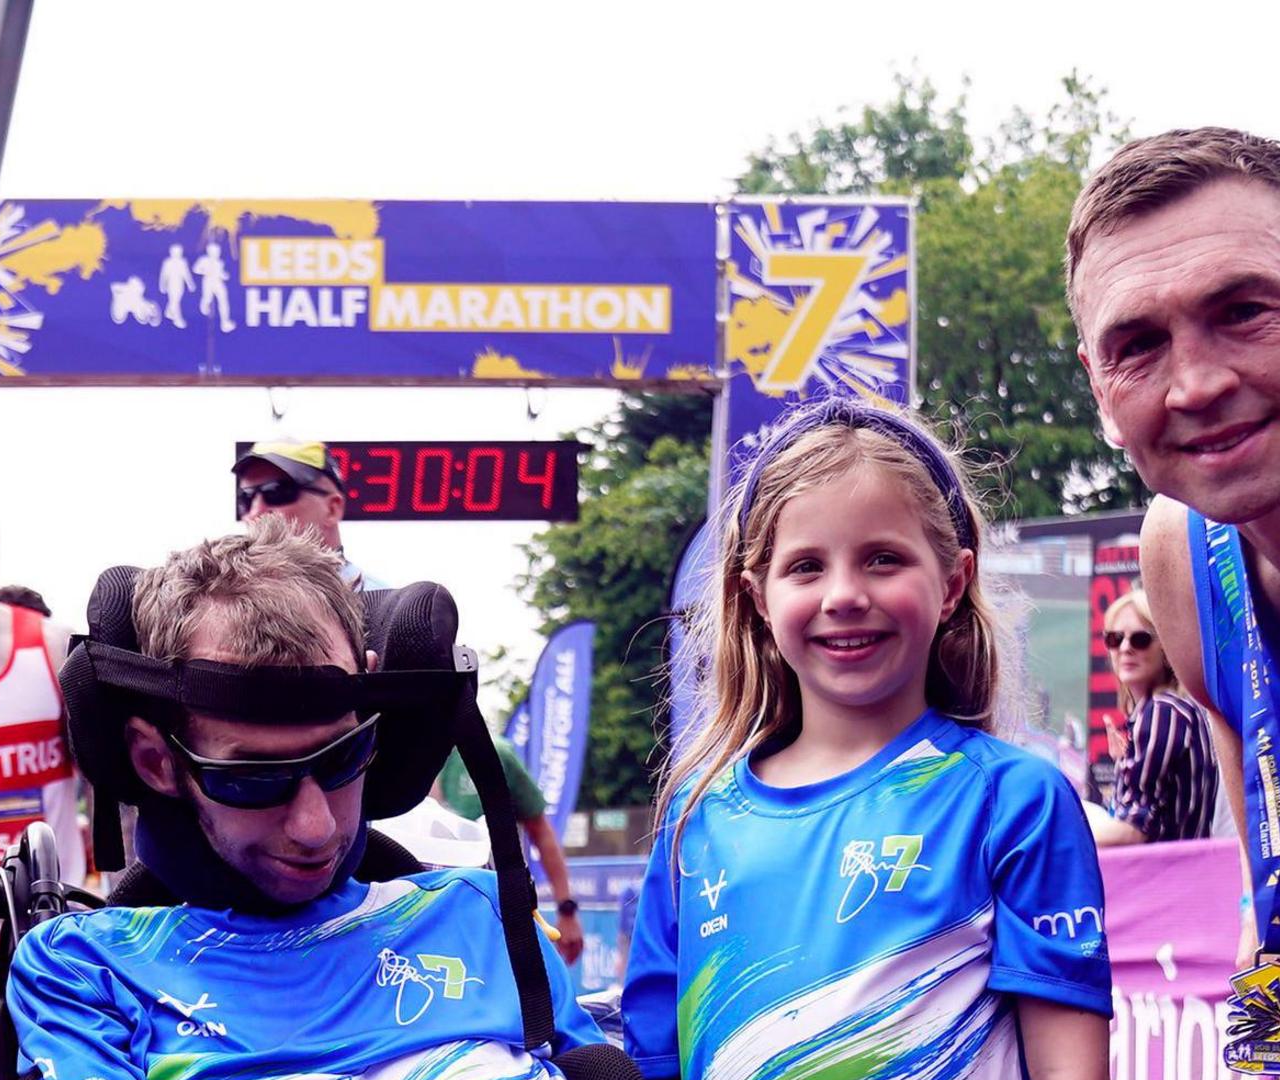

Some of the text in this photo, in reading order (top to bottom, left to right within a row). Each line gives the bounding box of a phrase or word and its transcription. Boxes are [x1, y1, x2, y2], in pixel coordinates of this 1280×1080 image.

[246, 241, 377, 281] LEEDS
[245, 287, 666, 329] HALF MARATHON
[1248, 659, 1261, 700] 2024
[1259, 821, 1271, 859] Clarion
[699, 914, 728, 938] OXEN
